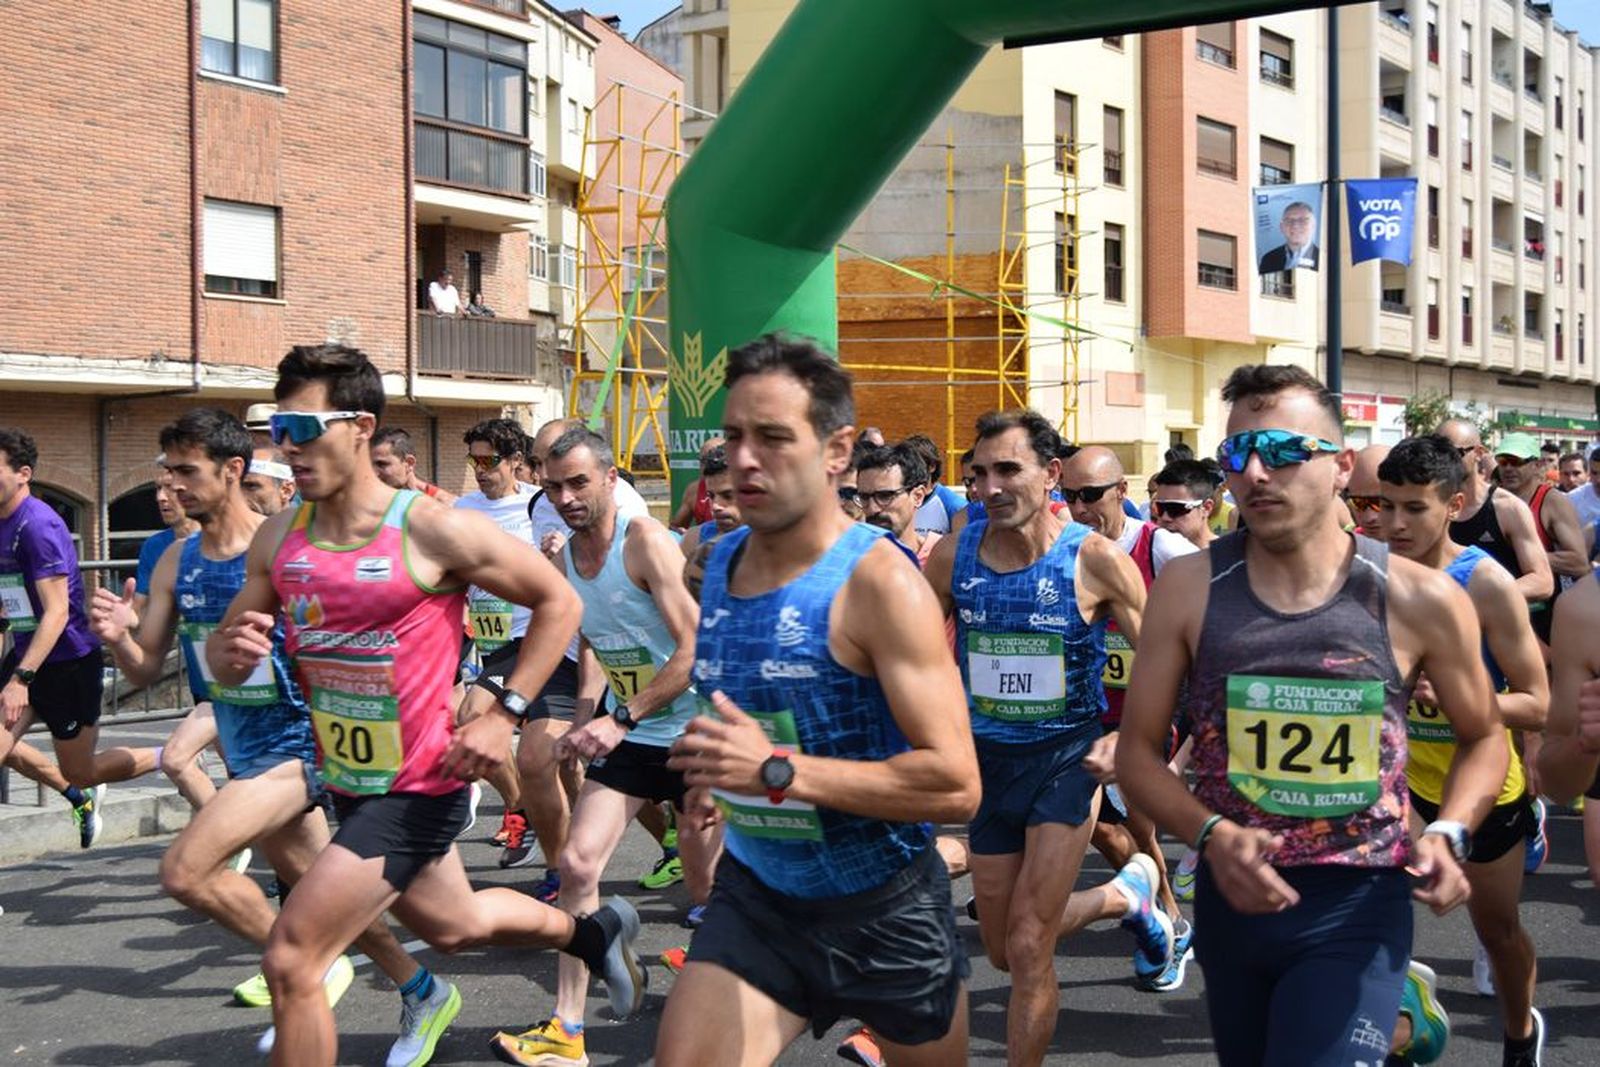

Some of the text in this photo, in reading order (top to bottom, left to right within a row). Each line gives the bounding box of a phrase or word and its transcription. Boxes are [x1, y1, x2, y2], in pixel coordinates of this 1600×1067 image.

[1359, 199, 1403, 212] VOTA
[475, 616, 504, 638] 114
[993, 637, 1050, 648] FUNDACION
[1018, 646, 1049, 655] RURAL
[1100, 653, 1125, 680] 9
[999, 673, 1033, 694] FENI
[1274, 684, 1364, 701] FUNDACION
[1023, 703, 1060, 715] RURAL
[1313, 701, 1362, 713] RURAL
[329, 721, 375, 765] 20
[1244, 719, 1355, 775] 124
[1313, 791, 1368, 807] RURAL
